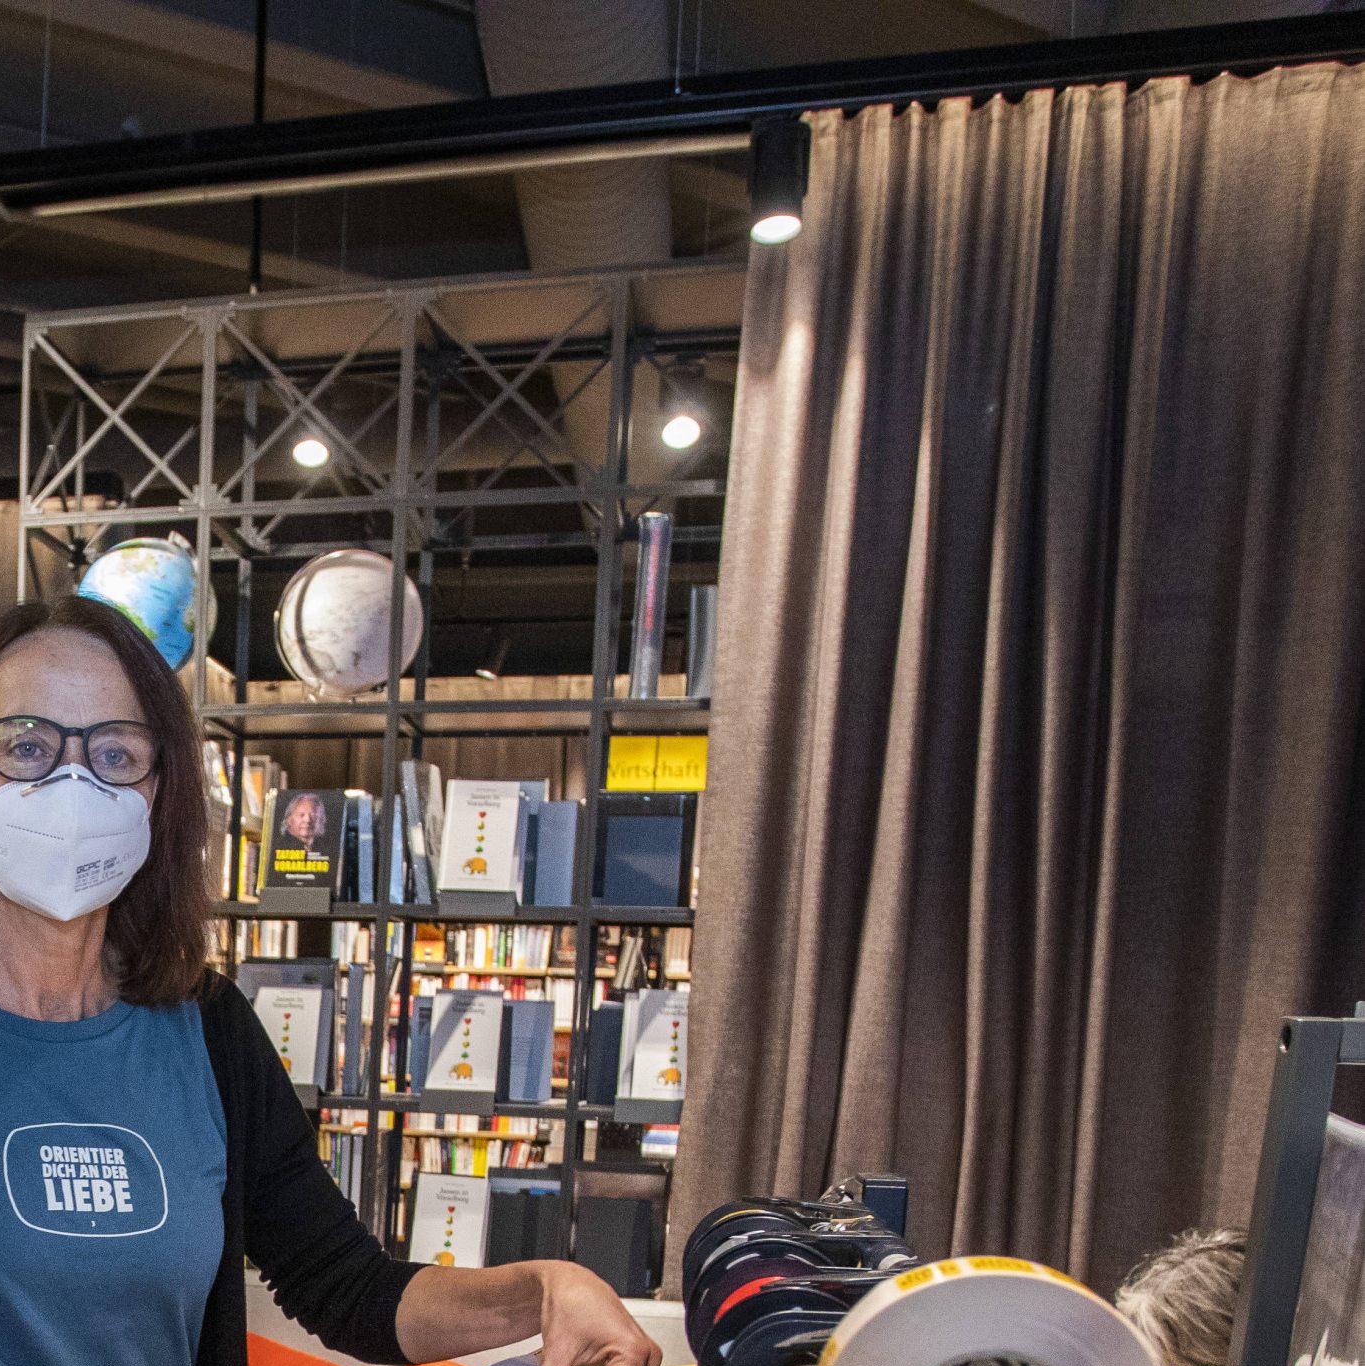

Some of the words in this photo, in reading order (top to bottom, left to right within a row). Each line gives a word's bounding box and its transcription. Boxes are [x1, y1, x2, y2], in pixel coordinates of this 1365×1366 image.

[39, 1145, 126, 1165] ORIENTIER
[42, 1163, 76, 1178] DICH
[79, 1164, 100, 1179] AN
[102, 1165, 129, 1180] DER
[43, 1178, 134, 1213] LIEBE
